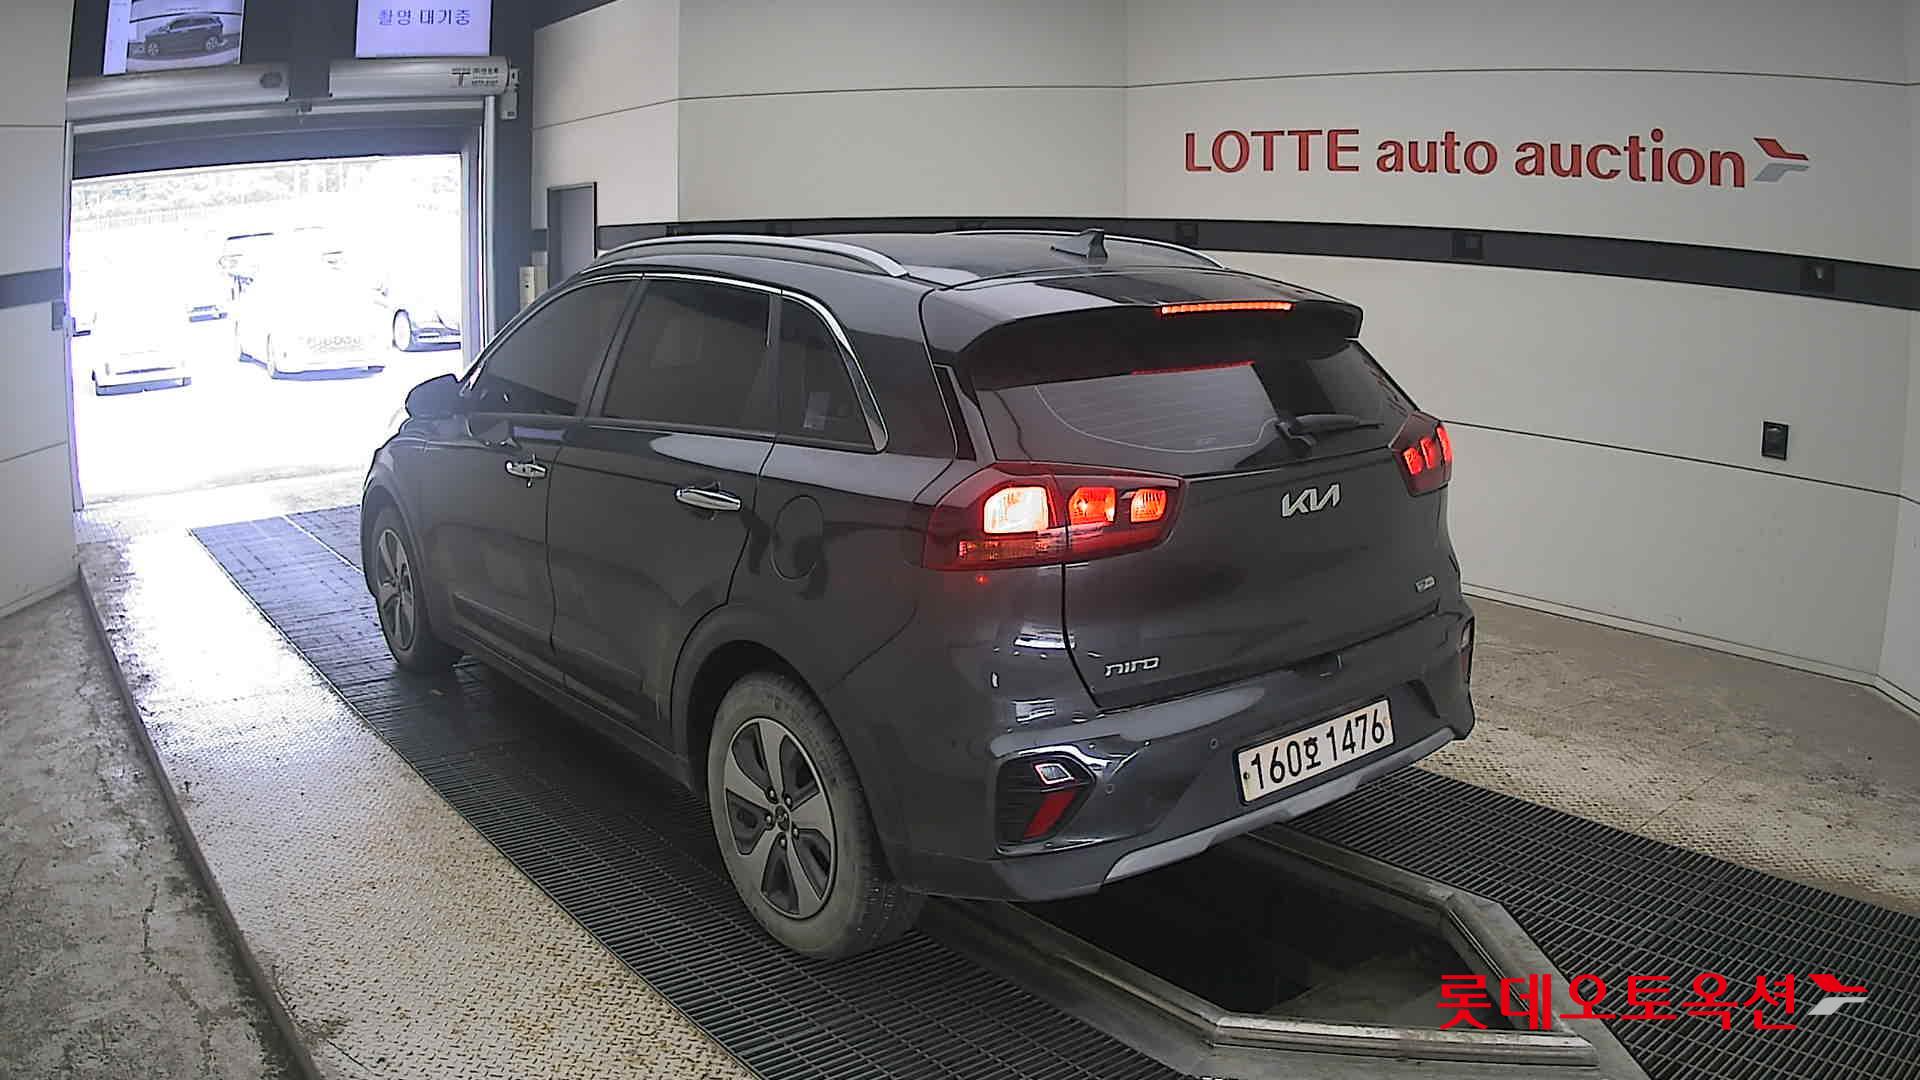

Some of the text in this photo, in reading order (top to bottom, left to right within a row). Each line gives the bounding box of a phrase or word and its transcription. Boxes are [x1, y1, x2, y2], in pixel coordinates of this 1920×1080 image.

[379, 8, 472, 26] 촬영 대기중
[1184, 128, 1746, 188] LOTTE auto auction
[1250, 708, 1385, 790] 160호 1476
